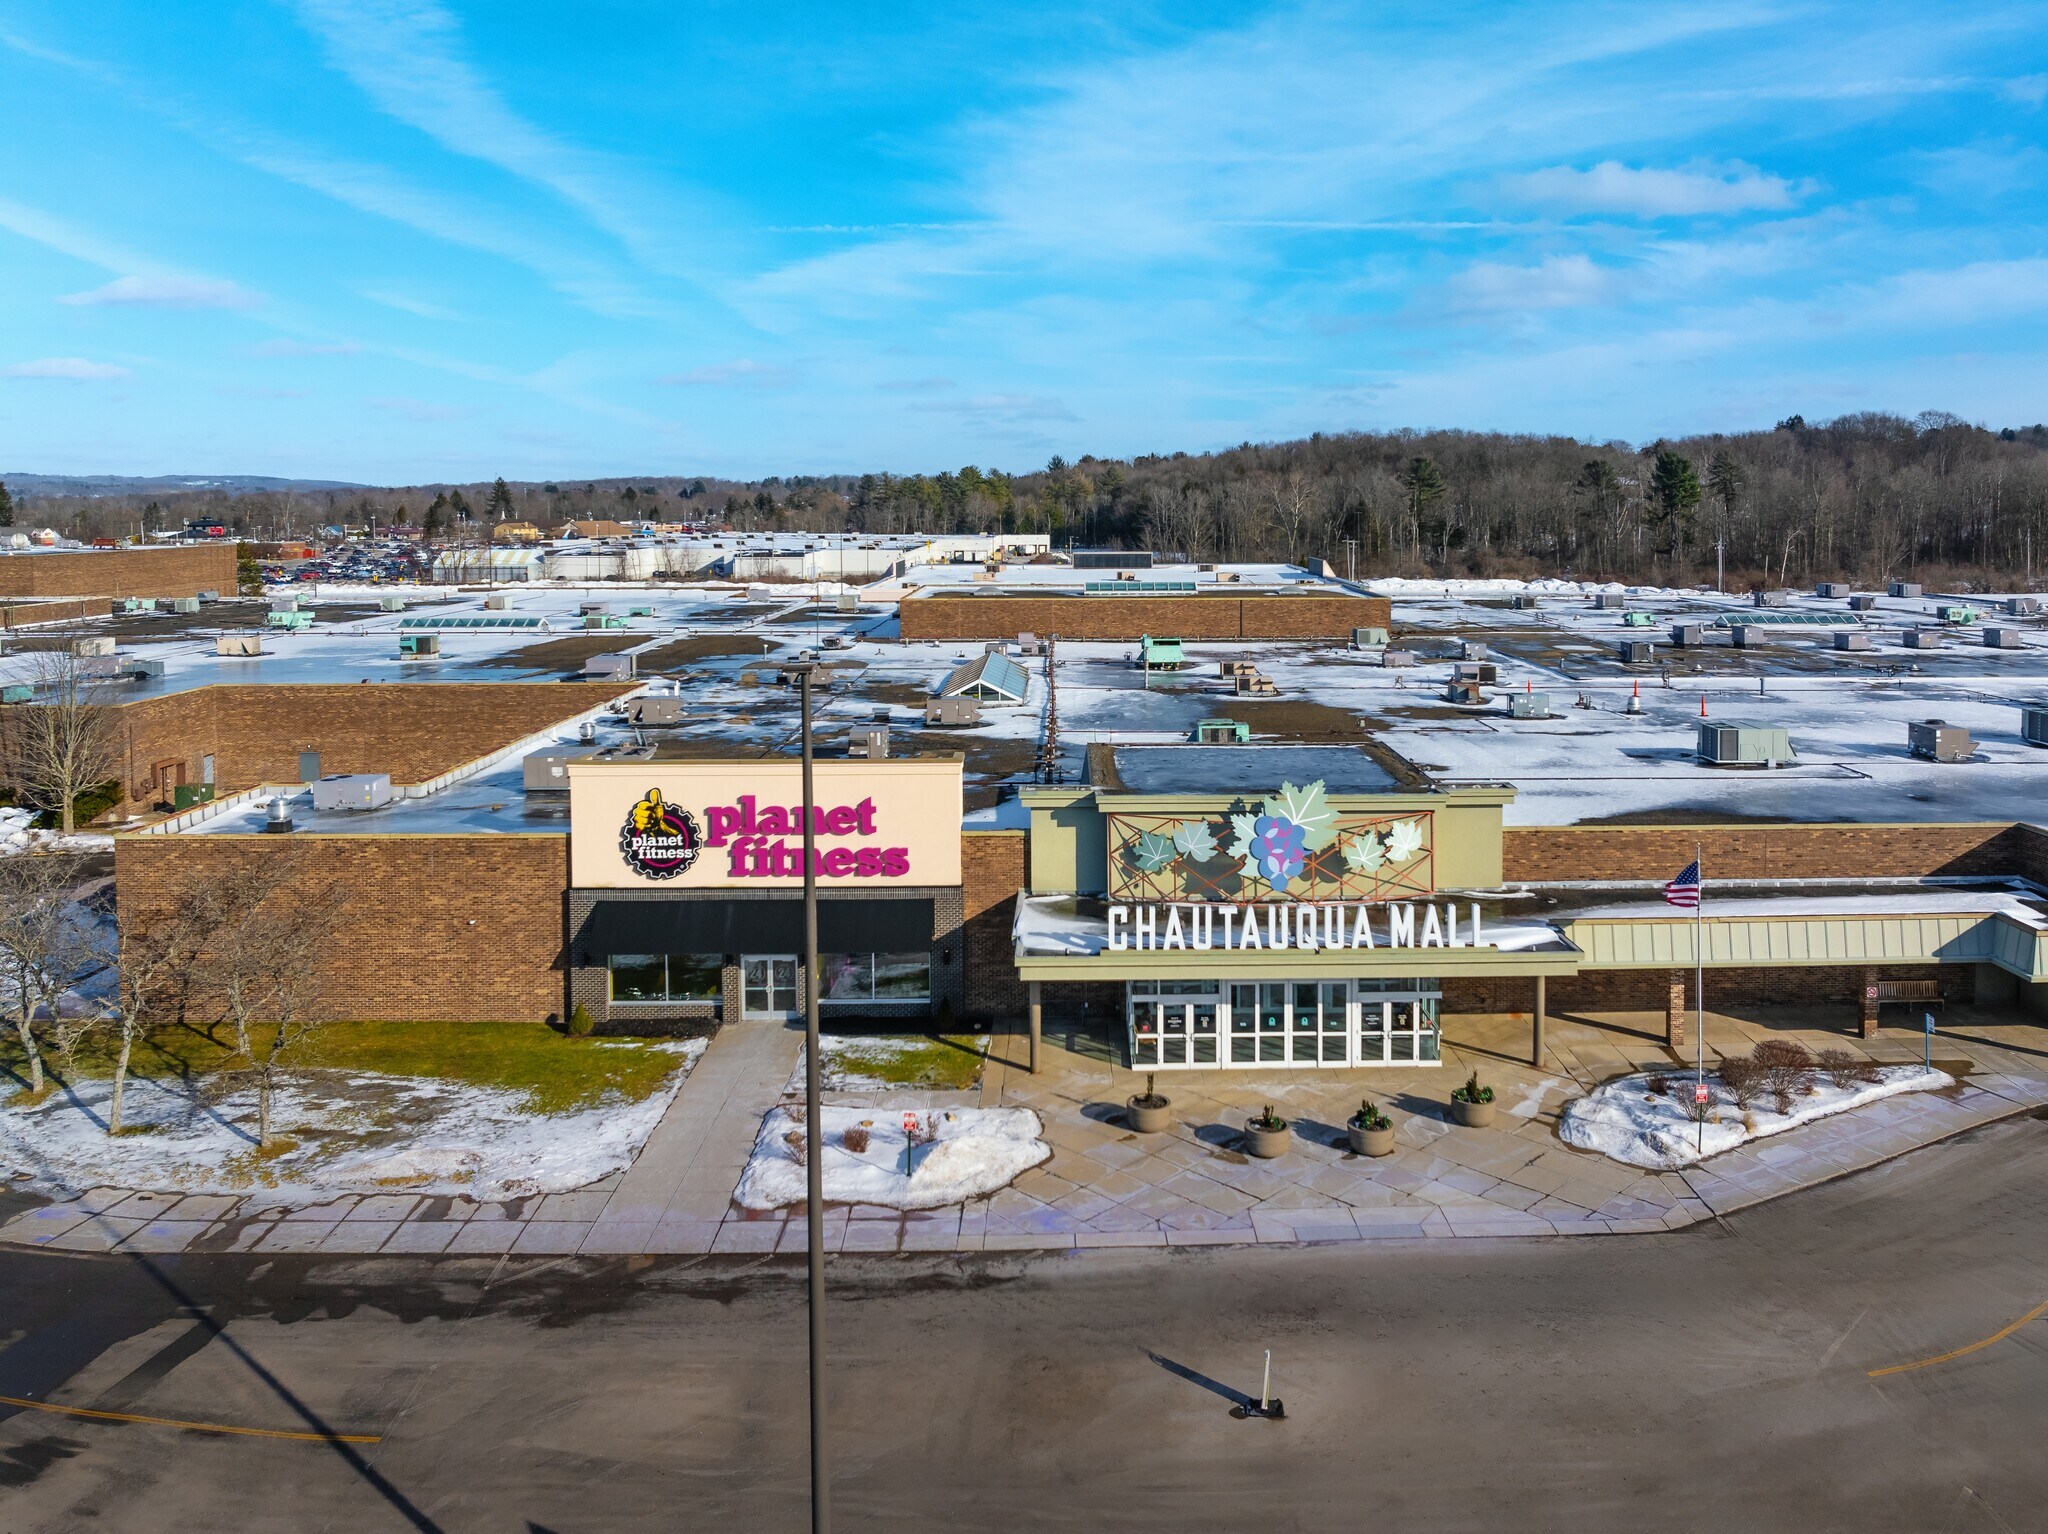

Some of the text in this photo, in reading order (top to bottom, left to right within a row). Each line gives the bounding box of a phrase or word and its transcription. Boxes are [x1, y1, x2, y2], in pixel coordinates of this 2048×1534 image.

[704, 795, 877, 847] planet
[631, 834, 683, 850] planet
[638, 846, 693, 859] fitness
[727, 836, 910, 877] fitness
[1108, 903, 1491, 951] CHAUTAUQUA MALL
